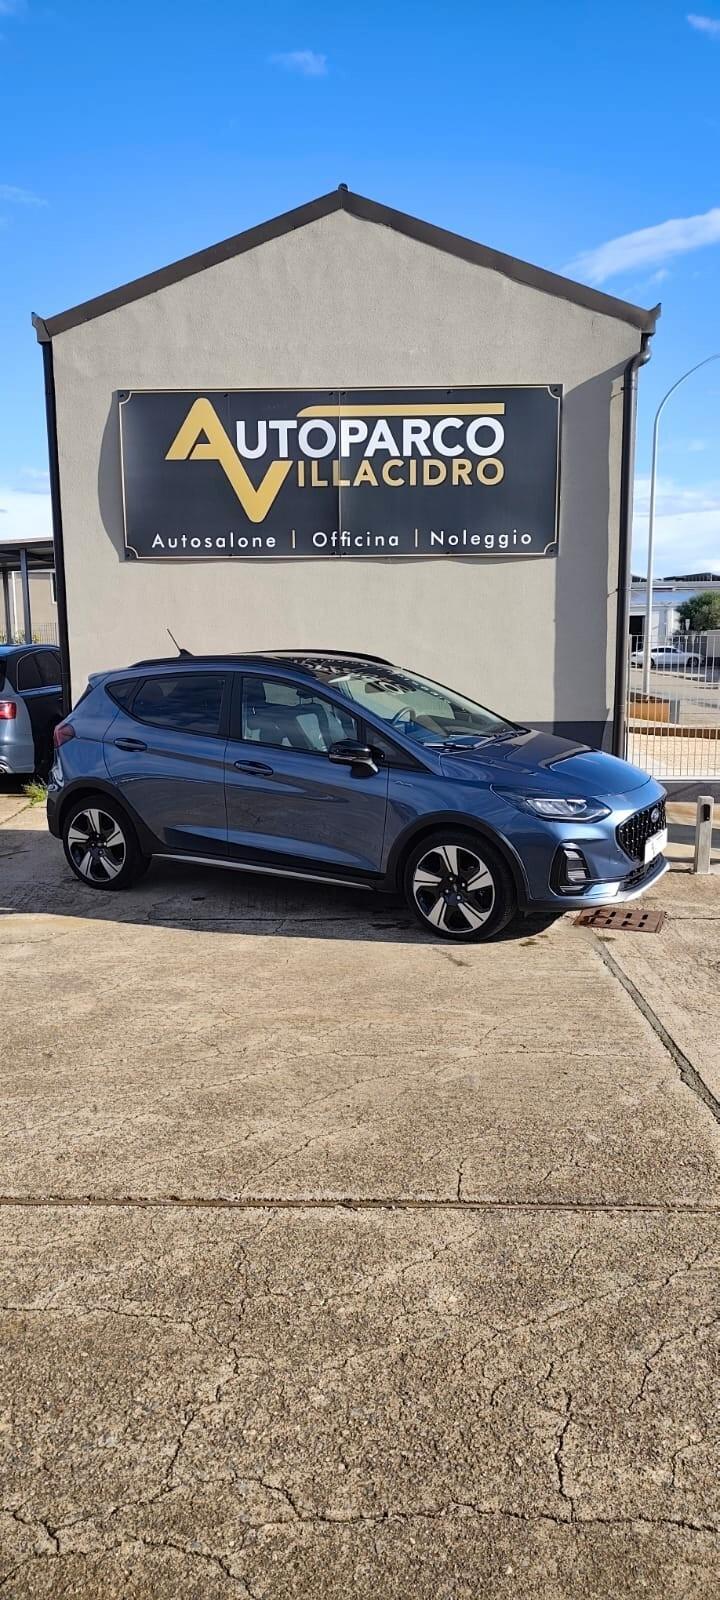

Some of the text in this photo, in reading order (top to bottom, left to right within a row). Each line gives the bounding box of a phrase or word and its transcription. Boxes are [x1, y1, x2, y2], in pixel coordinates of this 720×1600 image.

[165, 397, 505, 459] AUTOPARCO
[221, 458, 505, 522] VILLACIDRO
[152, 529, 533, 548] Autosalone Officina Noleggio
